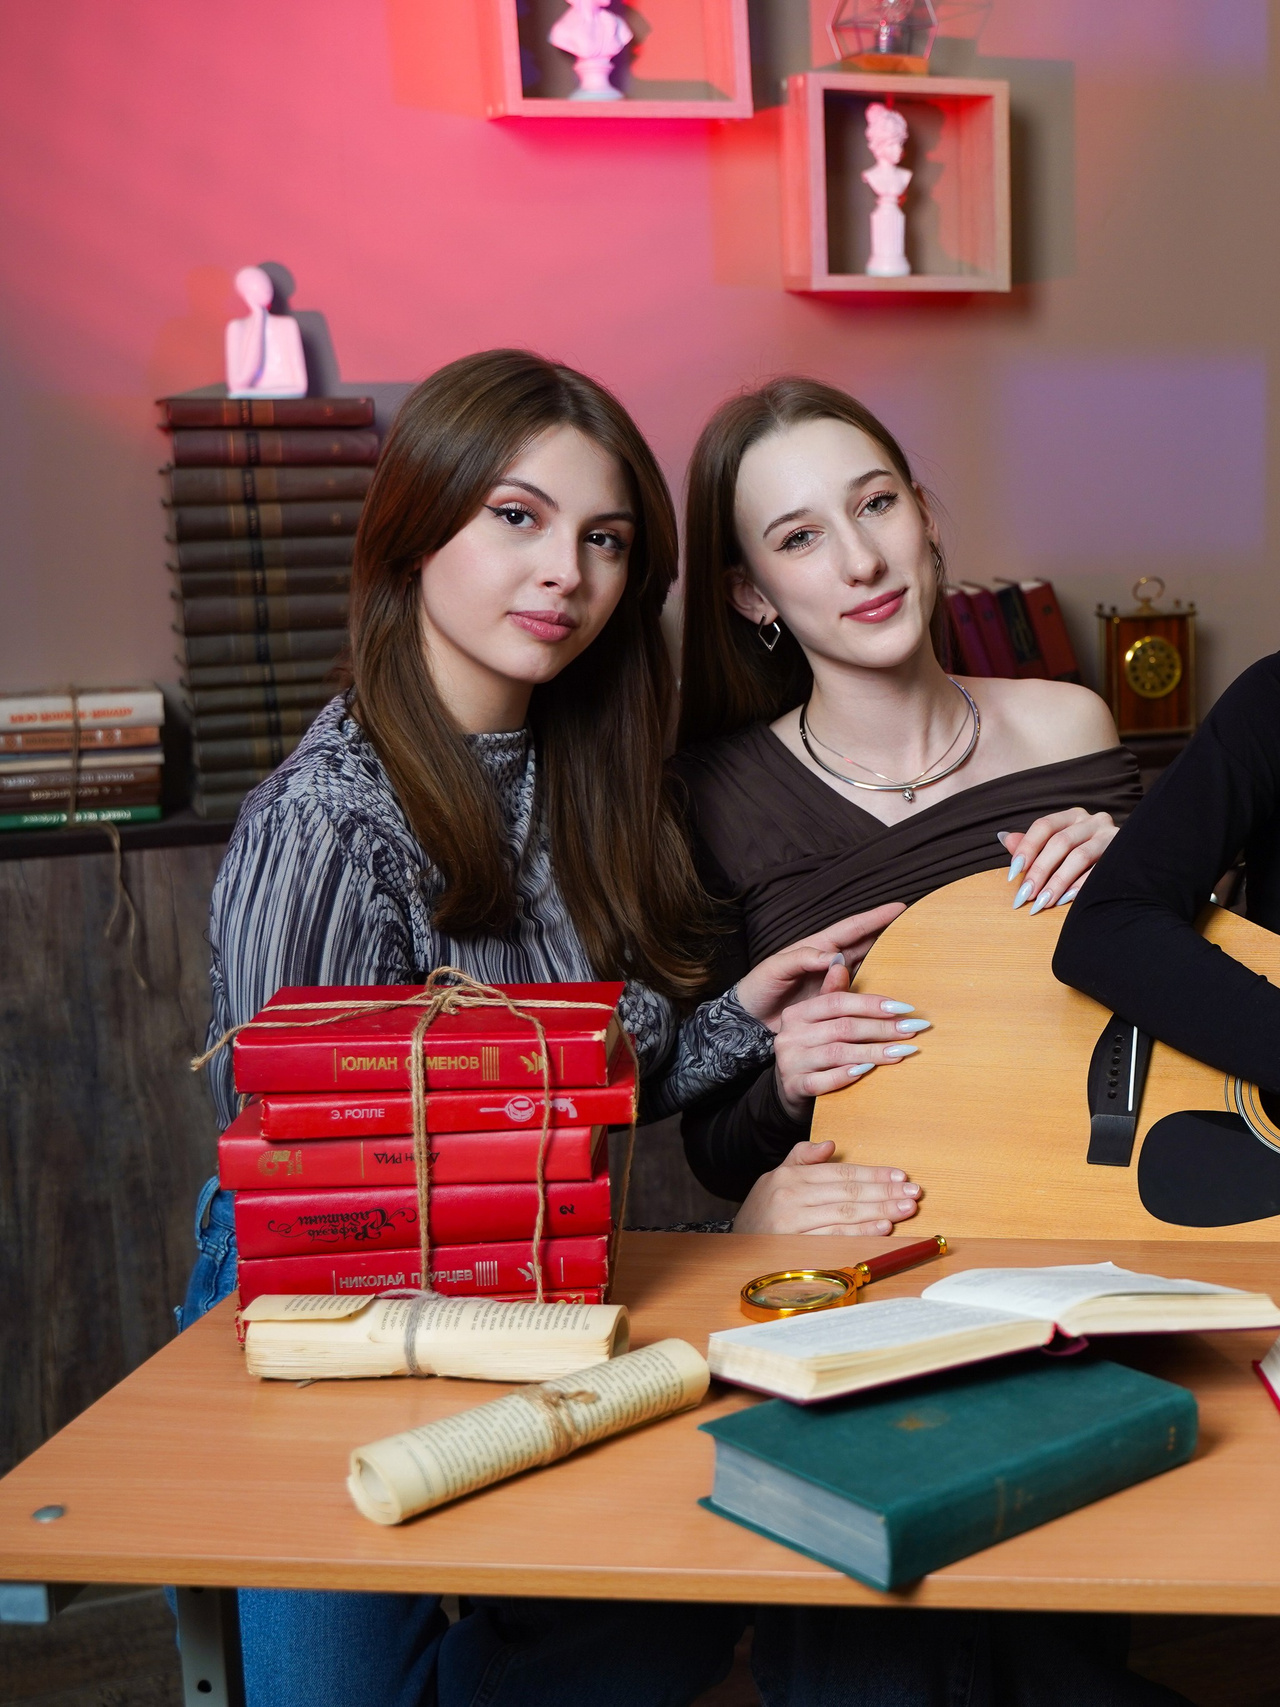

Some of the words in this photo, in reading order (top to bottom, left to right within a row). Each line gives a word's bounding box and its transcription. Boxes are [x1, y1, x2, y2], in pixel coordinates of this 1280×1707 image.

[341, 1056, 398, 1071] ЮЛИАН
[404, 1055, 480, 1070] СМЕНОВ
[331, 1110, 342, 1120] Э.
[345, 1108, 385, 1118] РОЛЛЕ
[374, 1153, 402, 1164] РИД
[339, 1272, 405, 1288] НИКОЛАЙ
[411, 1269, 473, 1283] ПУРЦЕВ
